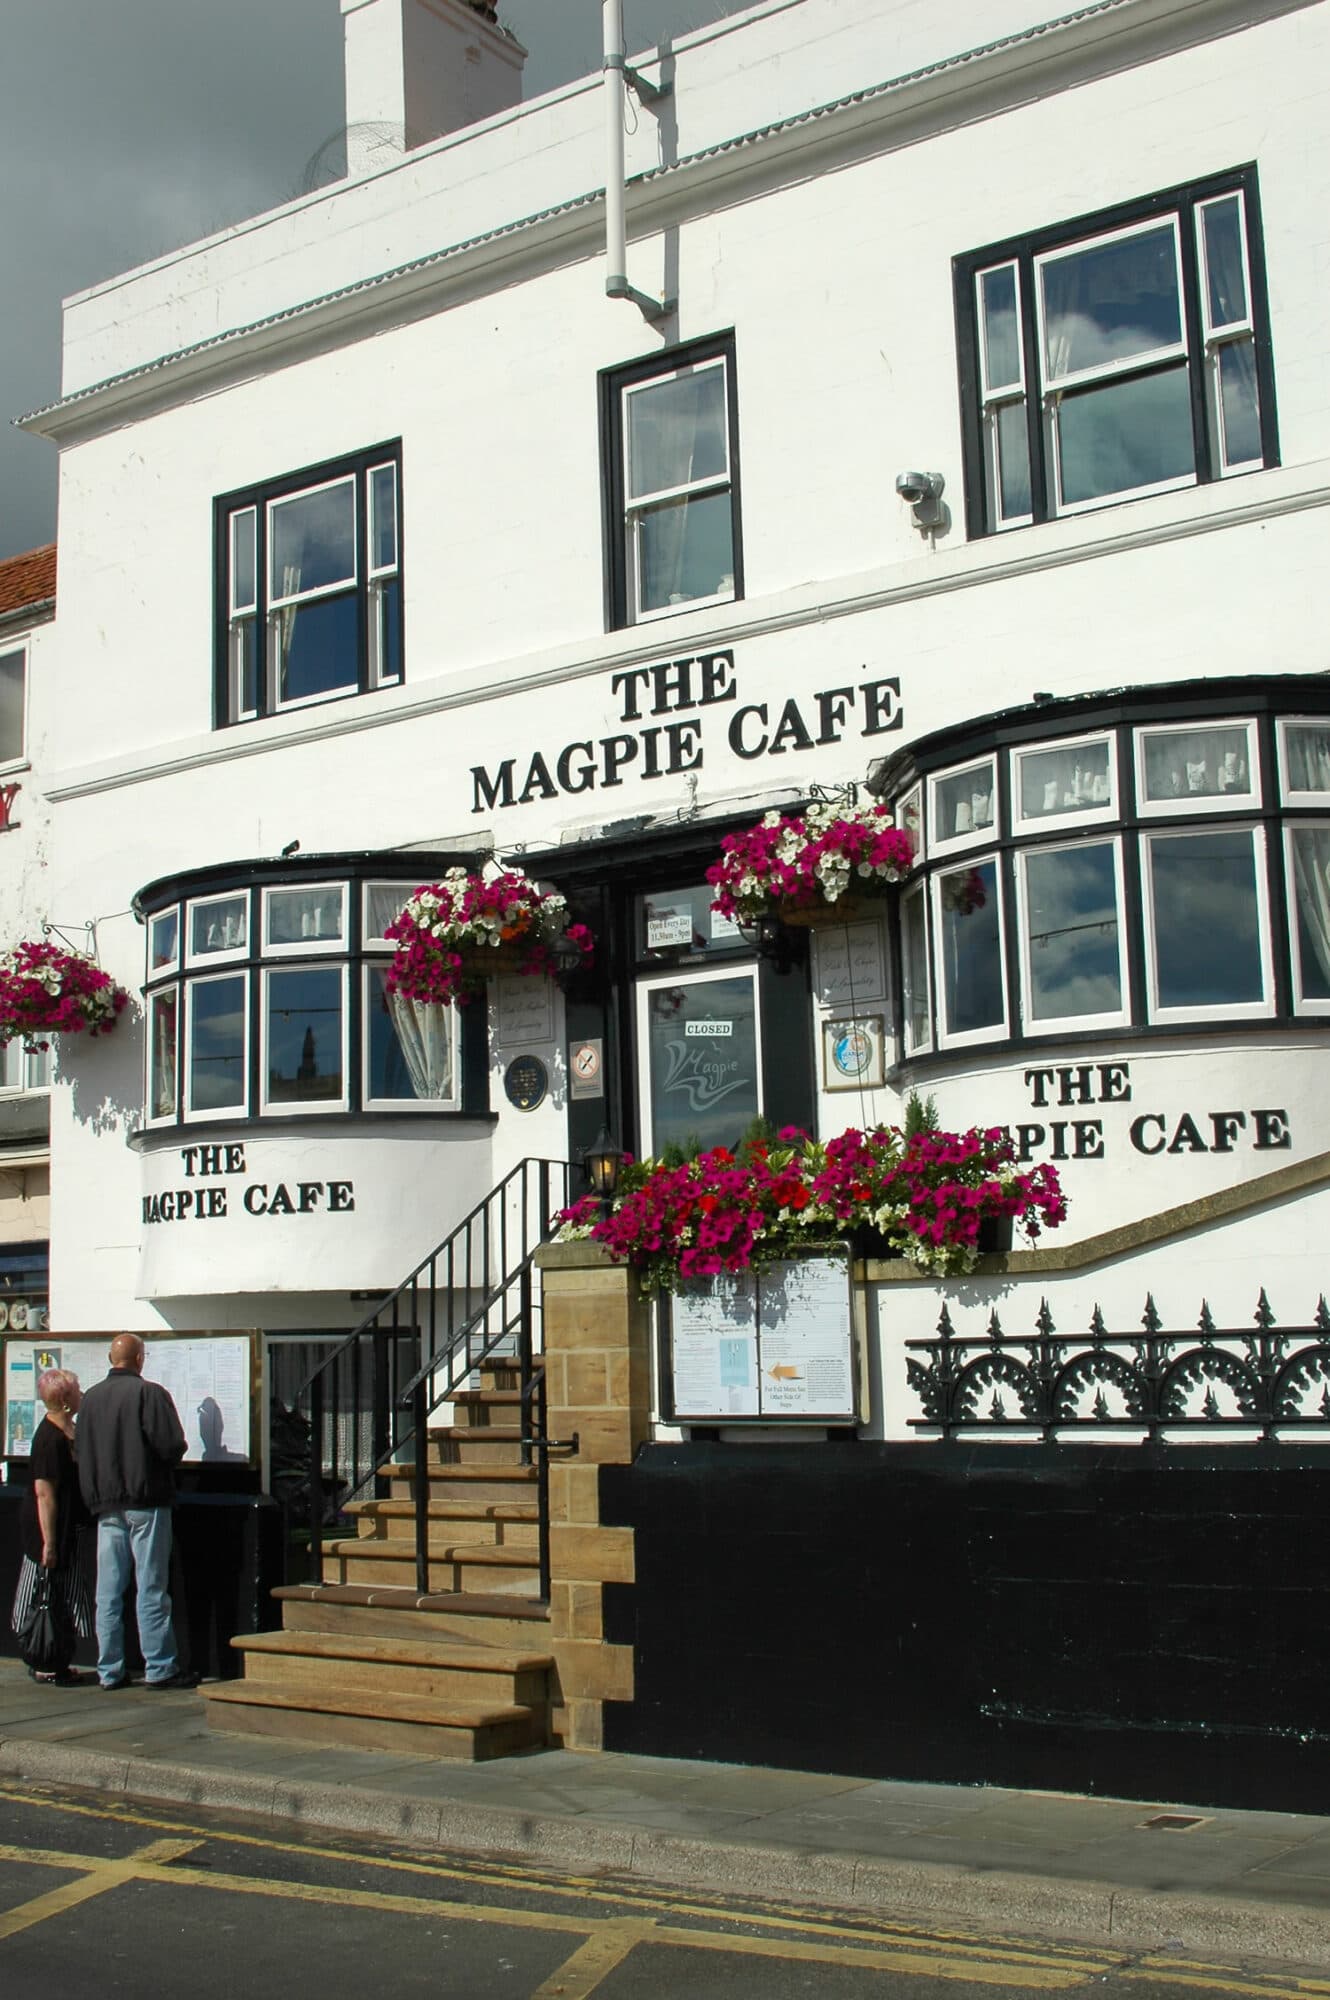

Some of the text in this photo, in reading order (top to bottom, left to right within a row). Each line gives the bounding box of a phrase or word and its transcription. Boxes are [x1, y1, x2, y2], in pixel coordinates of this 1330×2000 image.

[612, 649, 736, 721] THE
[470, 677, 903, 812] MAGPIE CAFE
[649, 922, 664, 932] Open
[664, 919, 679, 929] Every
[687, 1025, 730, 1034] CLOSED
[671, 1048, 738, 1090] Magpie
[1025, 1062, 1131, 1107] THE
[997, 1108, 1291, 1162] PIE CAFE
[182, 1143, 246, 1176] THE
[243, 1181, 355, 1216] CAFE
